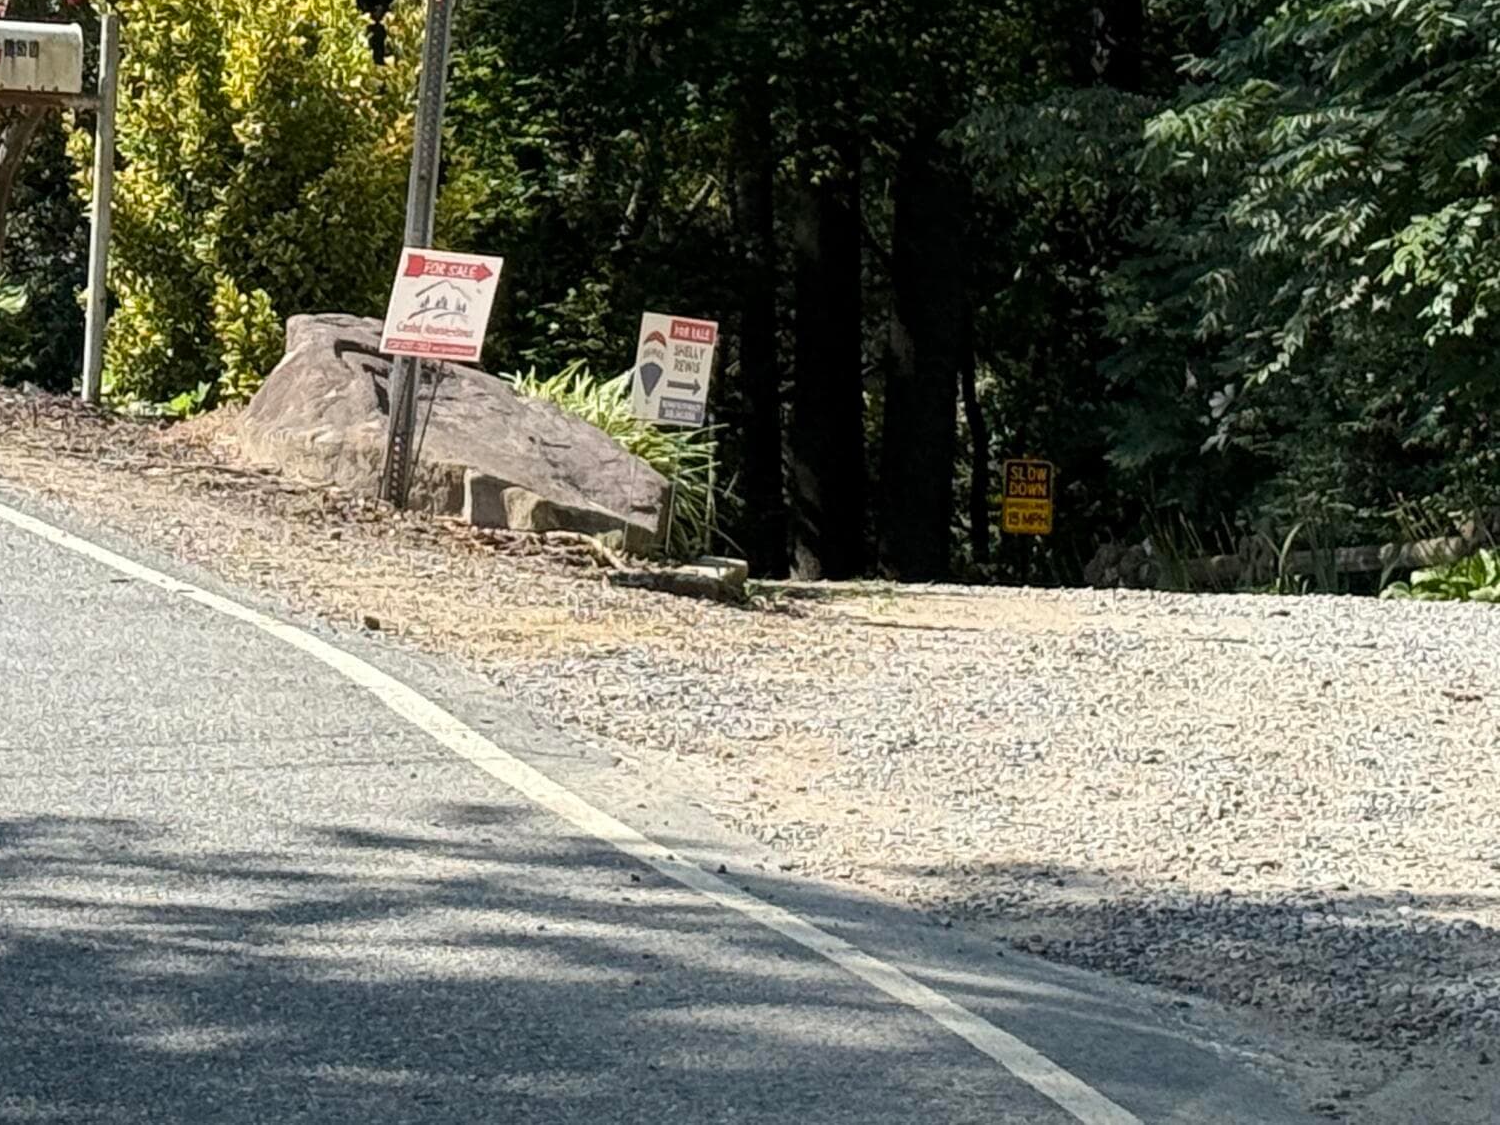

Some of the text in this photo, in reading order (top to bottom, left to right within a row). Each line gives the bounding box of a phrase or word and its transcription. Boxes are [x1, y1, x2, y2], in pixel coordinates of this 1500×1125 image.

[424, 261, 477, 277] FOR SALE
[1010, 466, 1047, 481] SLOW
[1009, 481, 1047, 495] DOWN
[1022, 512, 1047, 527] MPH
